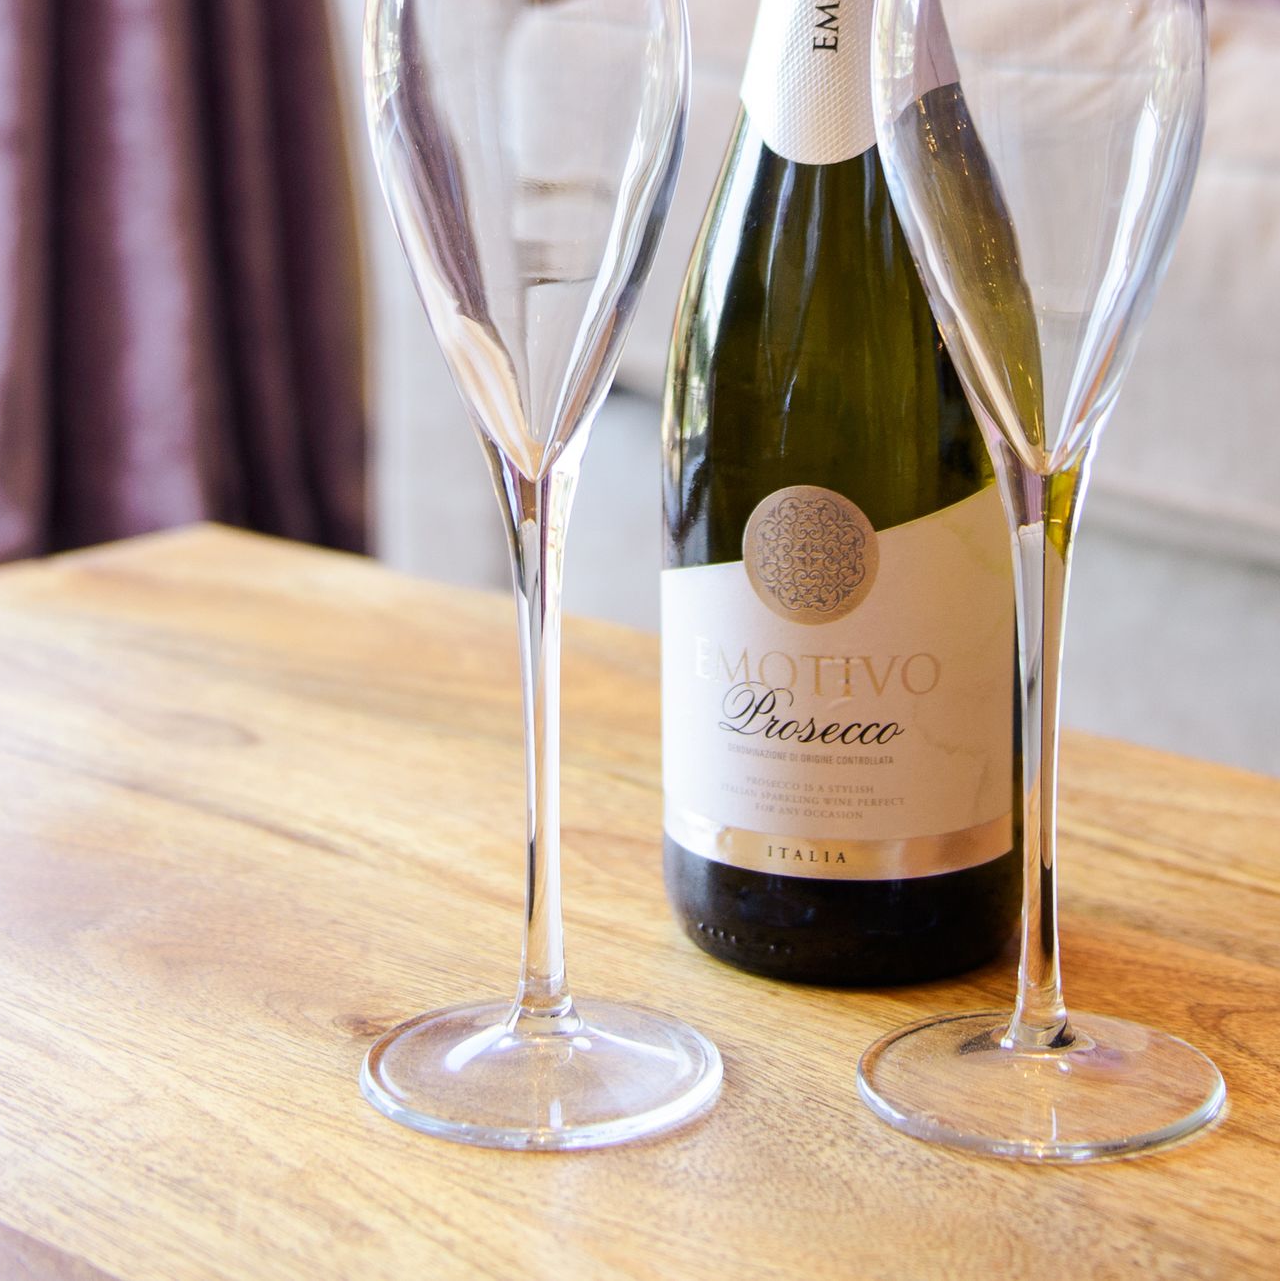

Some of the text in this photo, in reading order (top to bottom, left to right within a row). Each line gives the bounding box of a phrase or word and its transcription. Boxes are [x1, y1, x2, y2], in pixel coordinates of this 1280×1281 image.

[695, 635, 941, 698] EMOTIVO
[718, 681, 905, 745] Prosecco
[728, 743, 894, 765] DENOMINAZIONE DI ORIGINE CONTROLLATA
[746, 776, 800, 791] PROSECCO
[804, 782, 814, 792] IS
[828, 785, 874, 794] STYLISH
[760, 790, 819, 805] SPARKLING
[824, 797, 852, 807] WINE
[857, 797, 905, 807] PERFECT
[755, 802, 864, 819] FOR ANY OCCASION
[768, 845, 846, 864] ITALIA
